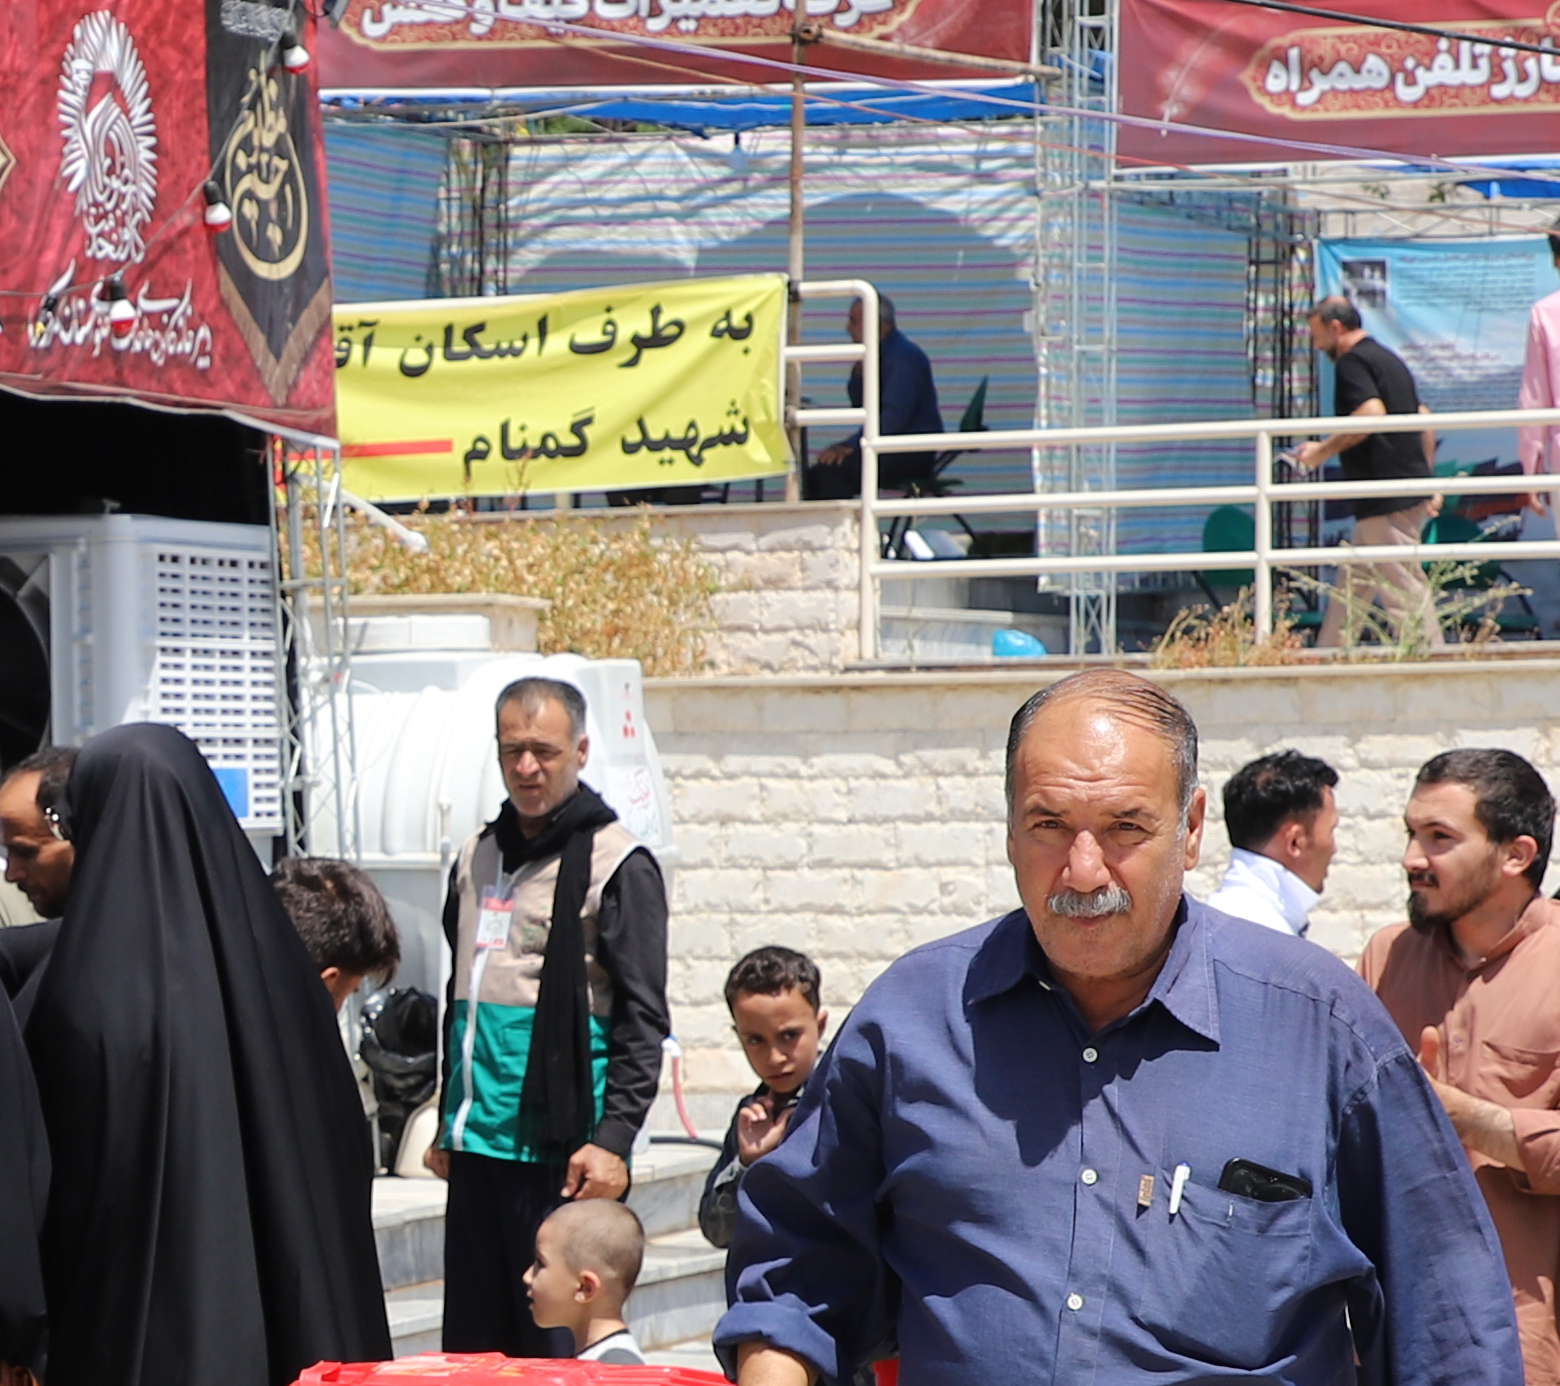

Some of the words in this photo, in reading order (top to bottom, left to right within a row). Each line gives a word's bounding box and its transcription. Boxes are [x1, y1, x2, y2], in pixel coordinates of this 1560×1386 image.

[1264, 45, 1394, 107] همراه
[1393, 35, 1491, 103] تلفن
[334, 320, 379, 370] آق
[399, 314, 549, 378] اسکان
[569, 304, 687, 369] طرف
[709, 308, 755, 356] به
[463, 406, 596, 476] گمنام
[621, 399, 751, 466] شهید
